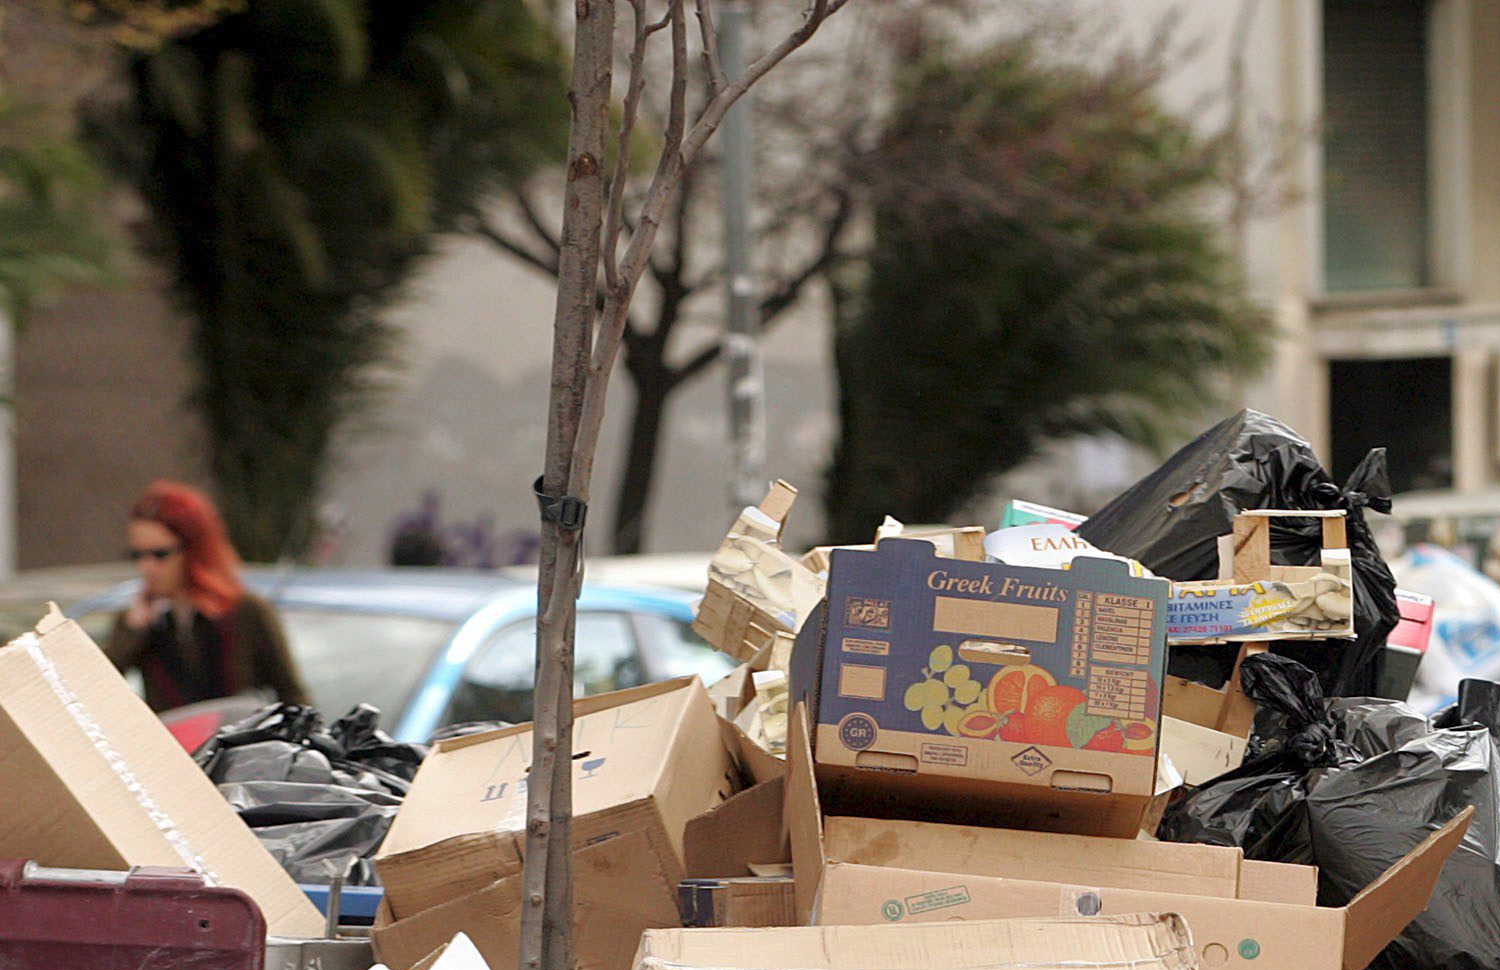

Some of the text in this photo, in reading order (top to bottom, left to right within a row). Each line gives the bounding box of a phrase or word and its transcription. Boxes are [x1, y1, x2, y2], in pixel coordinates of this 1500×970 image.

[926, 570, 1069, 602] Greek Fruits
[1104, 597, 1138, 608] KLASSE
[849, 726, 867, 739] GR
